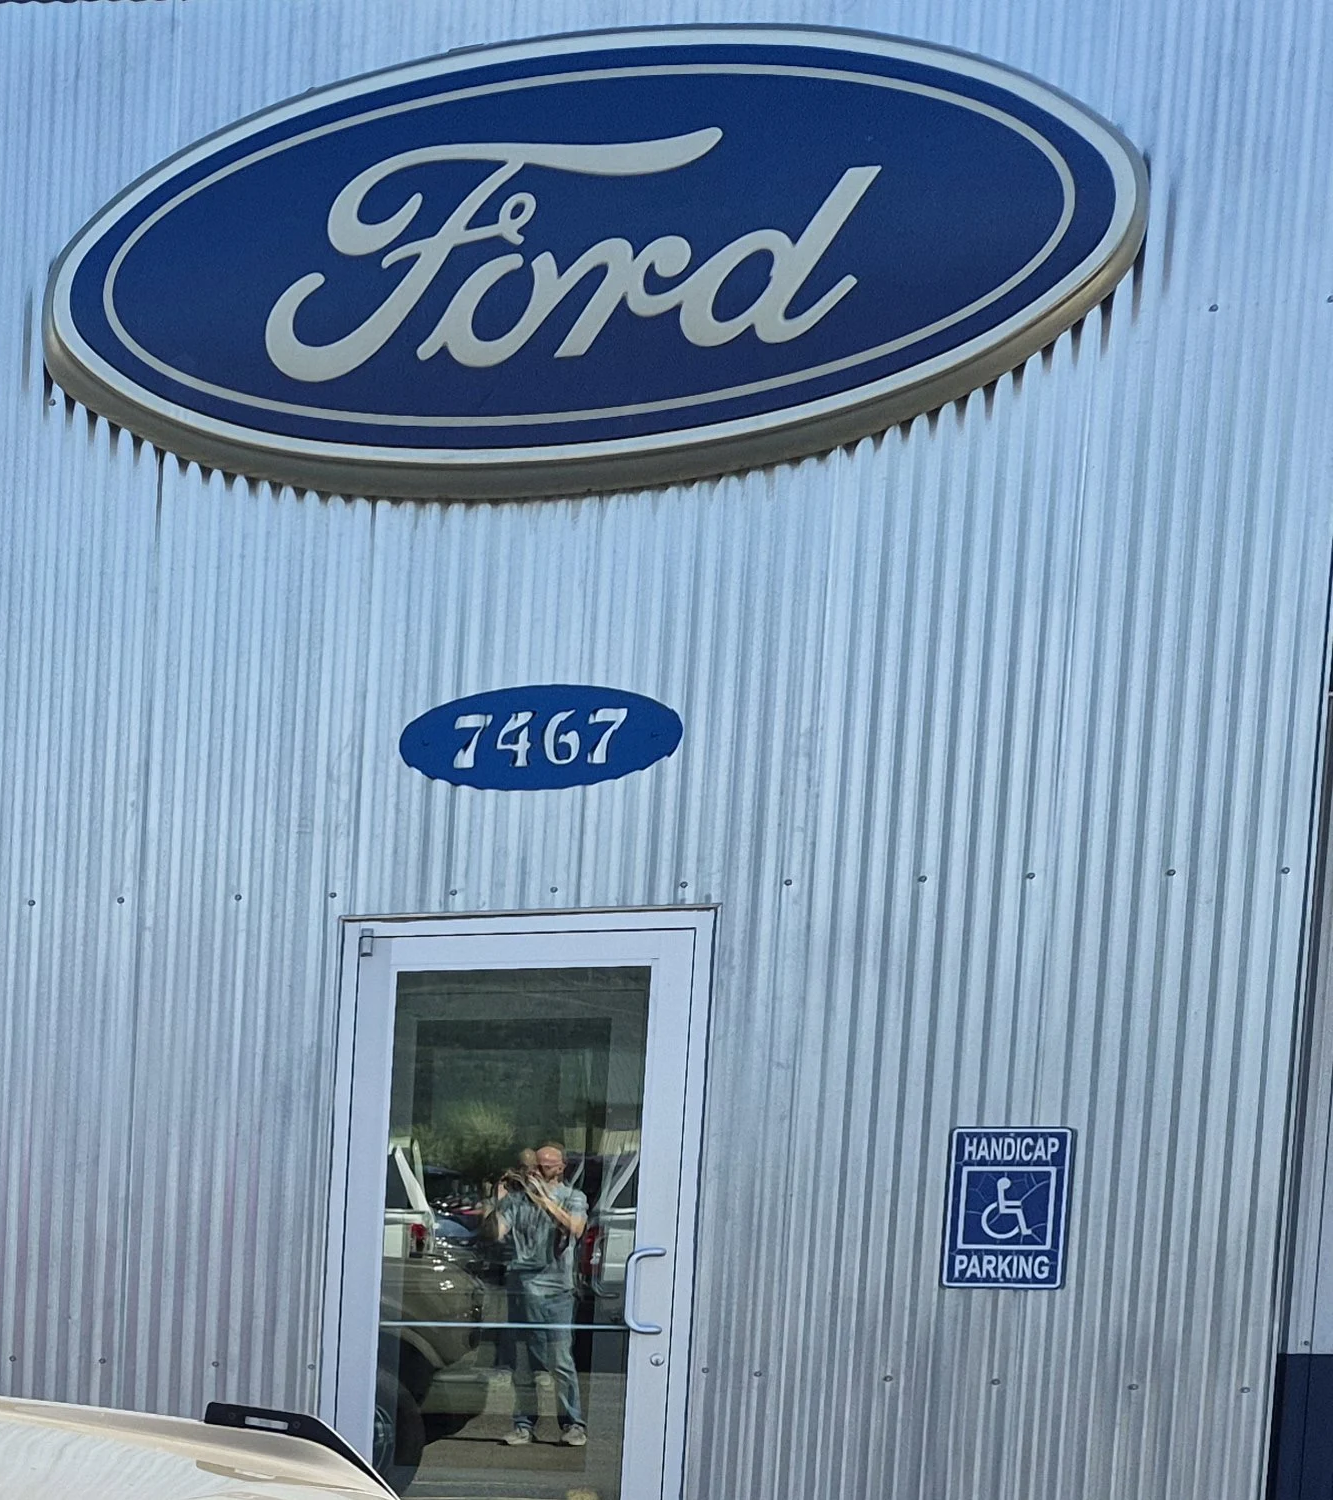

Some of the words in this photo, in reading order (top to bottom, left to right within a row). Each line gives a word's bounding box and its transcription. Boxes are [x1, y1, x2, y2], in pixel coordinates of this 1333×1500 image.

[264, 125, 881, 382] Ford
[454, 706, 628, 770] 7467
[963, 1136, 1060, 1161] HANDICAP
[954, 1254, 1050, 1280] PARKING
